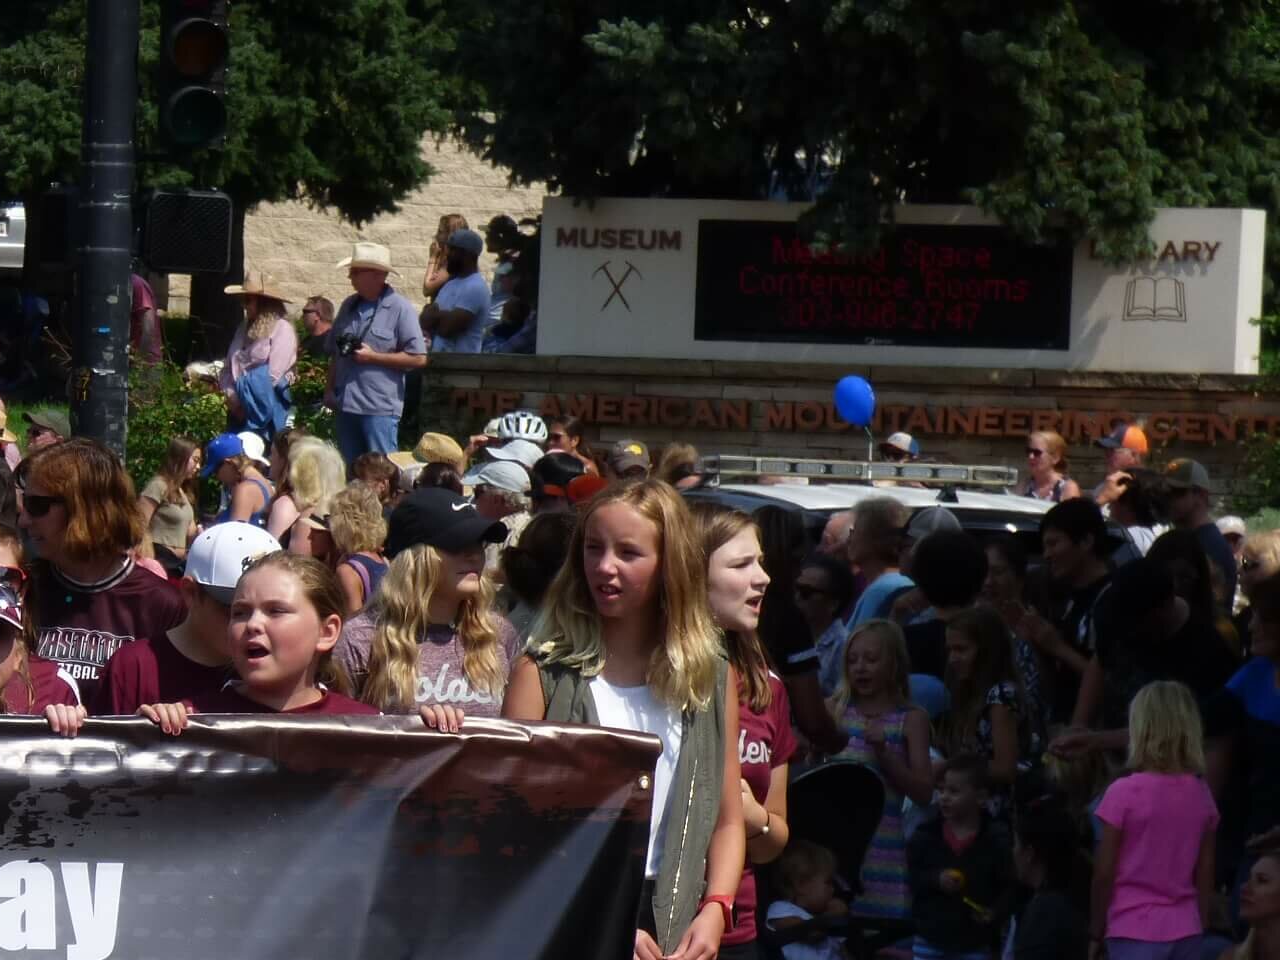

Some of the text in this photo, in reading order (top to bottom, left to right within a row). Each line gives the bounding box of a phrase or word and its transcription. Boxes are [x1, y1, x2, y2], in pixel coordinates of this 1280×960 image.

[556, 227, 683, 250] MUSEUM
[737, 264, 1033, 303] Conference Rooms
[540, 391, 752, 430] AMERICAN
[763, 400, 1133, 438] MOUTAINEERING
